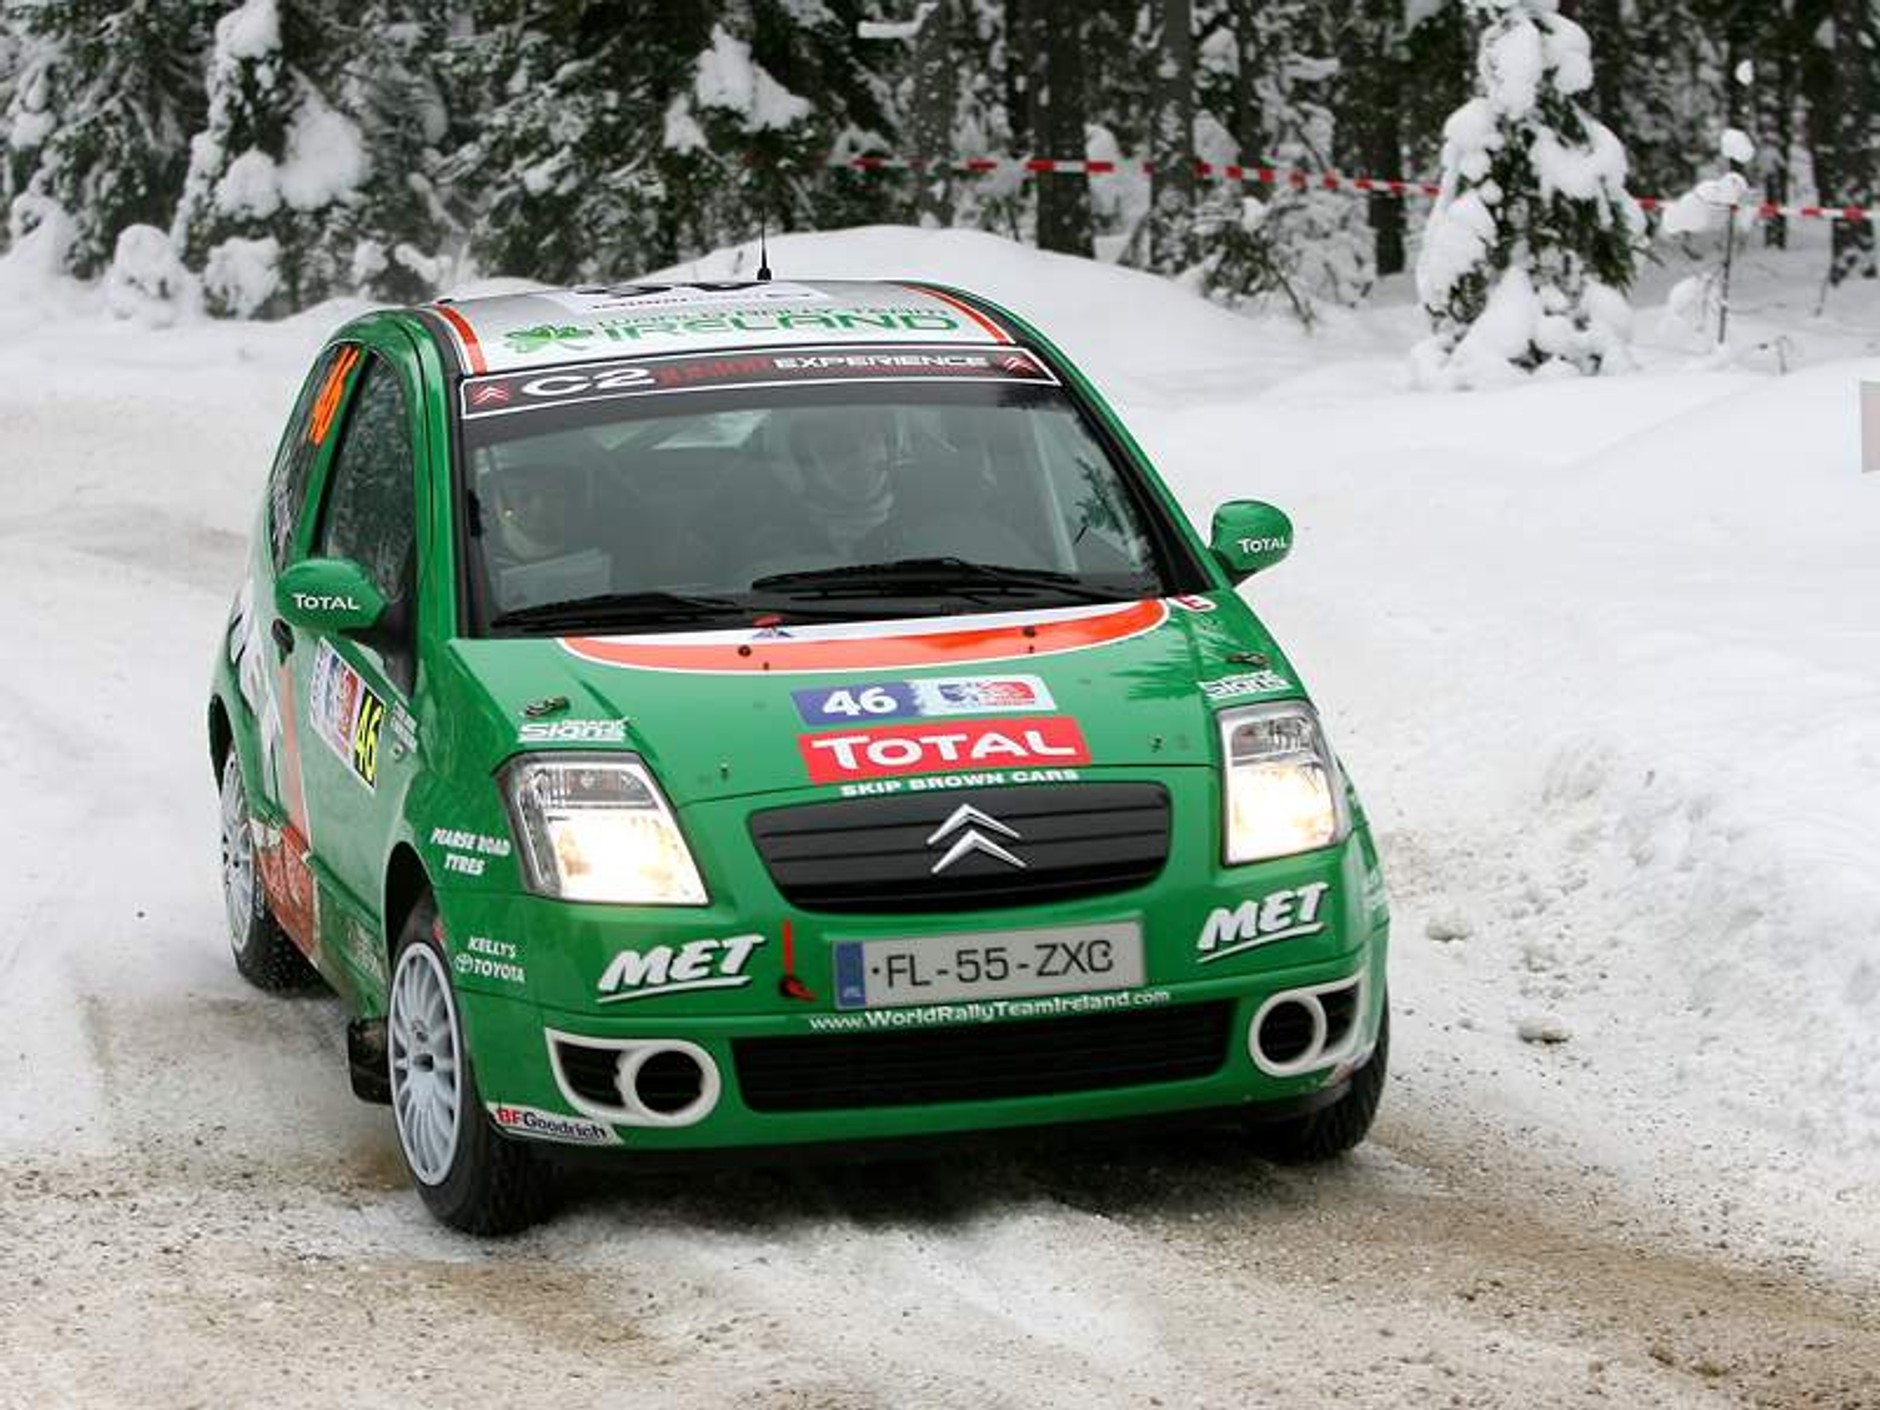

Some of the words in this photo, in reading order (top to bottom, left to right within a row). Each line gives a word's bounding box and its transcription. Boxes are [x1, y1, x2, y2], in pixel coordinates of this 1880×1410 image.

[604, 312, 960, 342] IRELAND
[521, 367, 658, 399] C2
[774, 355, 988, 370] EXPERIENCE
[1238, 536, 1287, 553] TOTAL
[293, 592, 361, 611] TOTAL
[822, 686, 898, 716] 46
[354, 694, 384, 784] 46
[812, 730, 1076, 770] TOTAL
[841, 781, 901, 797] SKIP
[910, 773, 1006, 791] BROWN
[1012, 769, 1080, 783] CARS
[444, 853, 486, 876] TYRES
[1197, 881, 1330, 951] MET
[474, 958, 526, 984] TOYOTA
[598, 933, 767, 992] MET
[809, 989, 1171, 1031] www.WorldRallyTeamIreland.com
[496, 1107, 608, 1140] BFGoodrich
